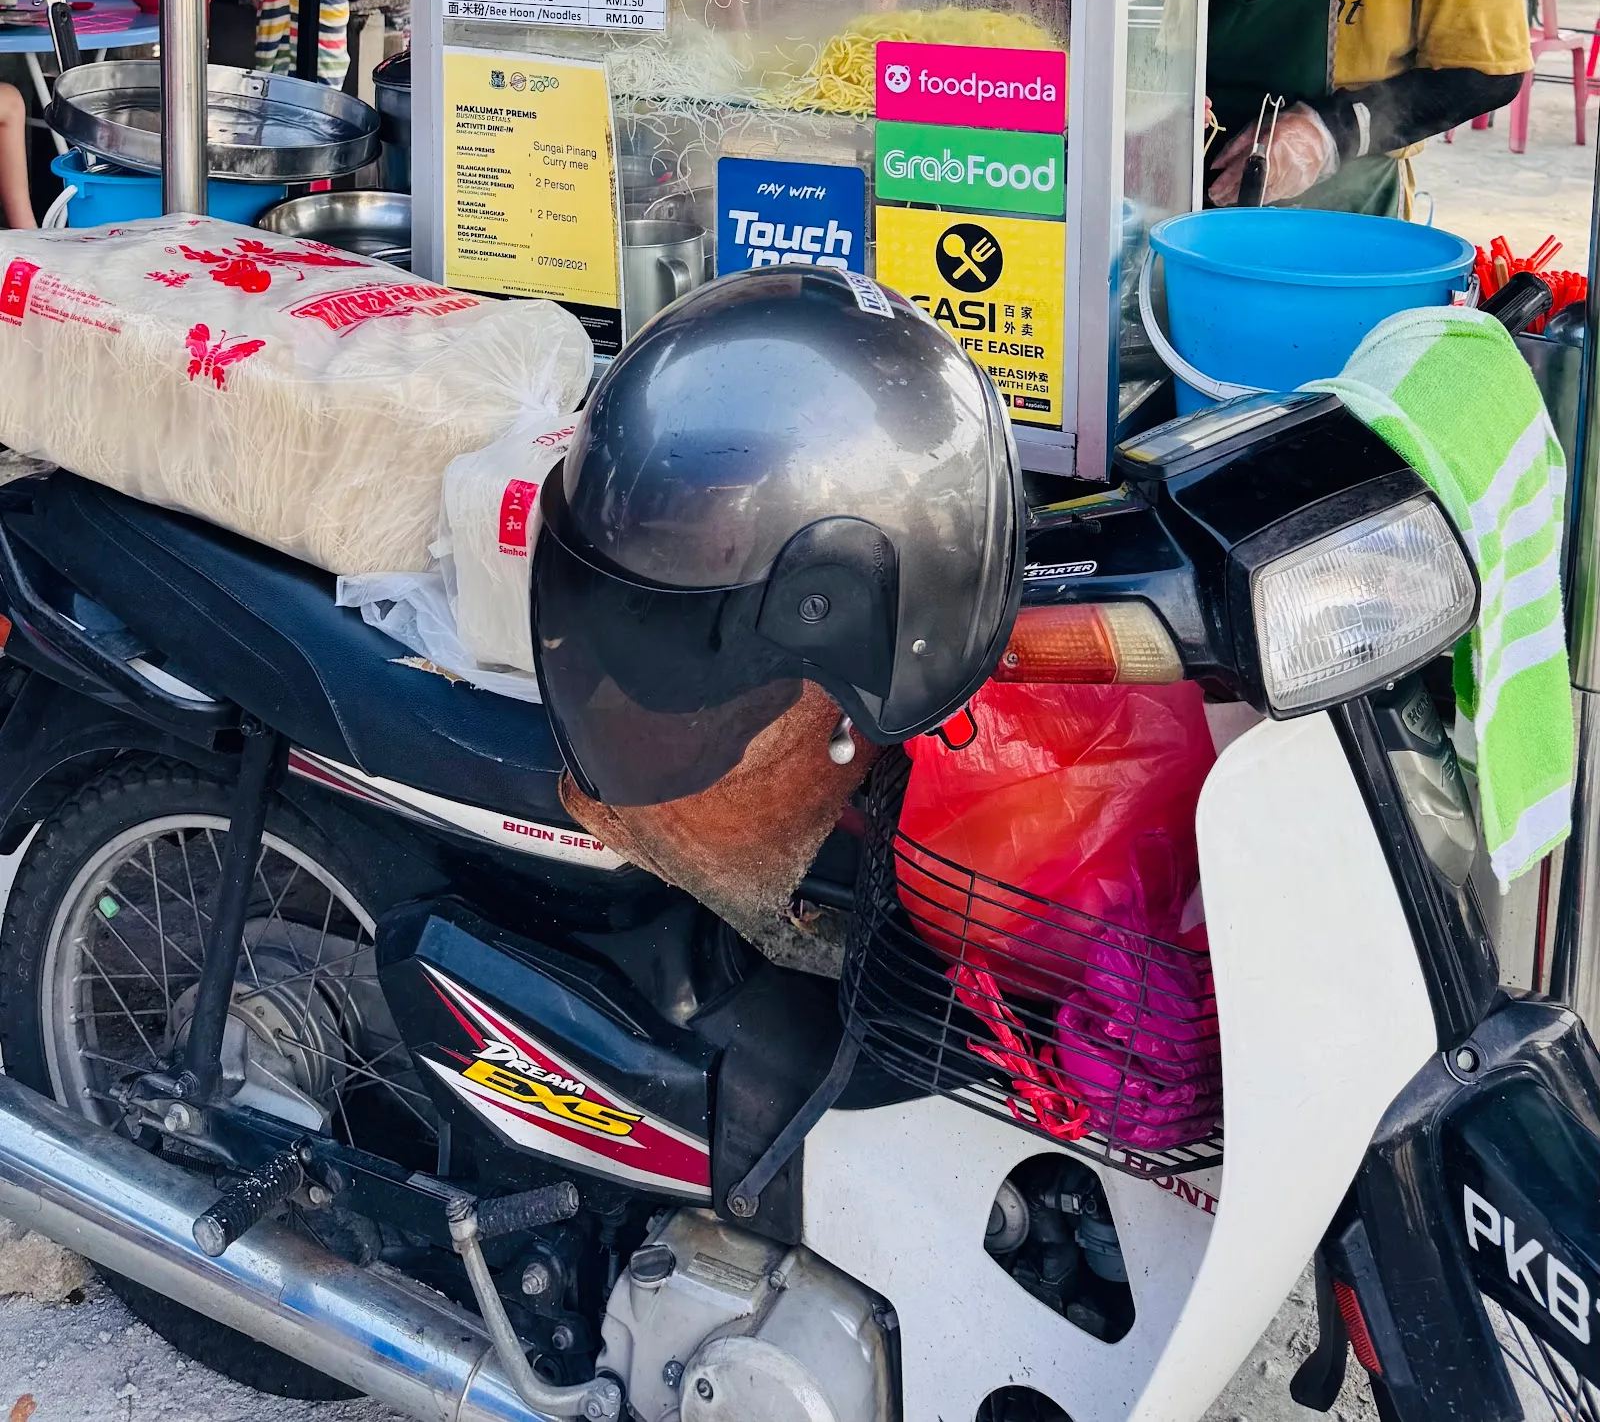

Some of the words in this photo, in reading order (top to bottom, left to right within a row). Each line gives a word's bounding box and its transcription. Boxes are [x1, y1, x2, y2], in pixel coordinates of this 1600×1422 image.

[509, 7, 535, 19] Hoon
[537, 8, 582, 21] /Noodles
[606, 13, 644, 25] RM1.00
[918, 69, 1057, 104] foodpanda
[456, 104, 504, 116] MAKLUMAT
[506, 109, 537, 120] PREMIS
[456, 112, 486, 121] BUSINESS
[456, 121, 486, 130] AKTIVITI
[487, 124, 514, 133] DINE-IN
[533, 140, 564, 155] Sungai
[566, 144, 597, 160] Pinang
[542, 155, 567, 171] Curry
[569, 161, 589, 171] mee
[883, 148, 1055, 192] GrabFood
[535, 178, 541, 188] 2
[544, 178, 576, 192] Person
[757, 182, 786, 199] PAY
[789, 185, 827, 201] WITH
[537, 209, 544, 220] 2
[546, 210, 578, 224] Person
[728, 209, 853, 256] Touch
[537, 256, 589, 271] 07/09/2021
[1004, 304, 1033, 320] 百家
[1004, 321, 1033, 337] 外卖
[957, 336, 983, 352] IFE
[988, 339, 1045, 359] EASIER
[998, 379, 1023, 390] WITH
[1026, 382, 1049, 393] EASI
[502, 820, 555, 842] BOON
[559, 835, 606, 852] SIEW
[472, 1038, 587, 1096] DREAM
[461, 1059, 644, 1136] EX5
